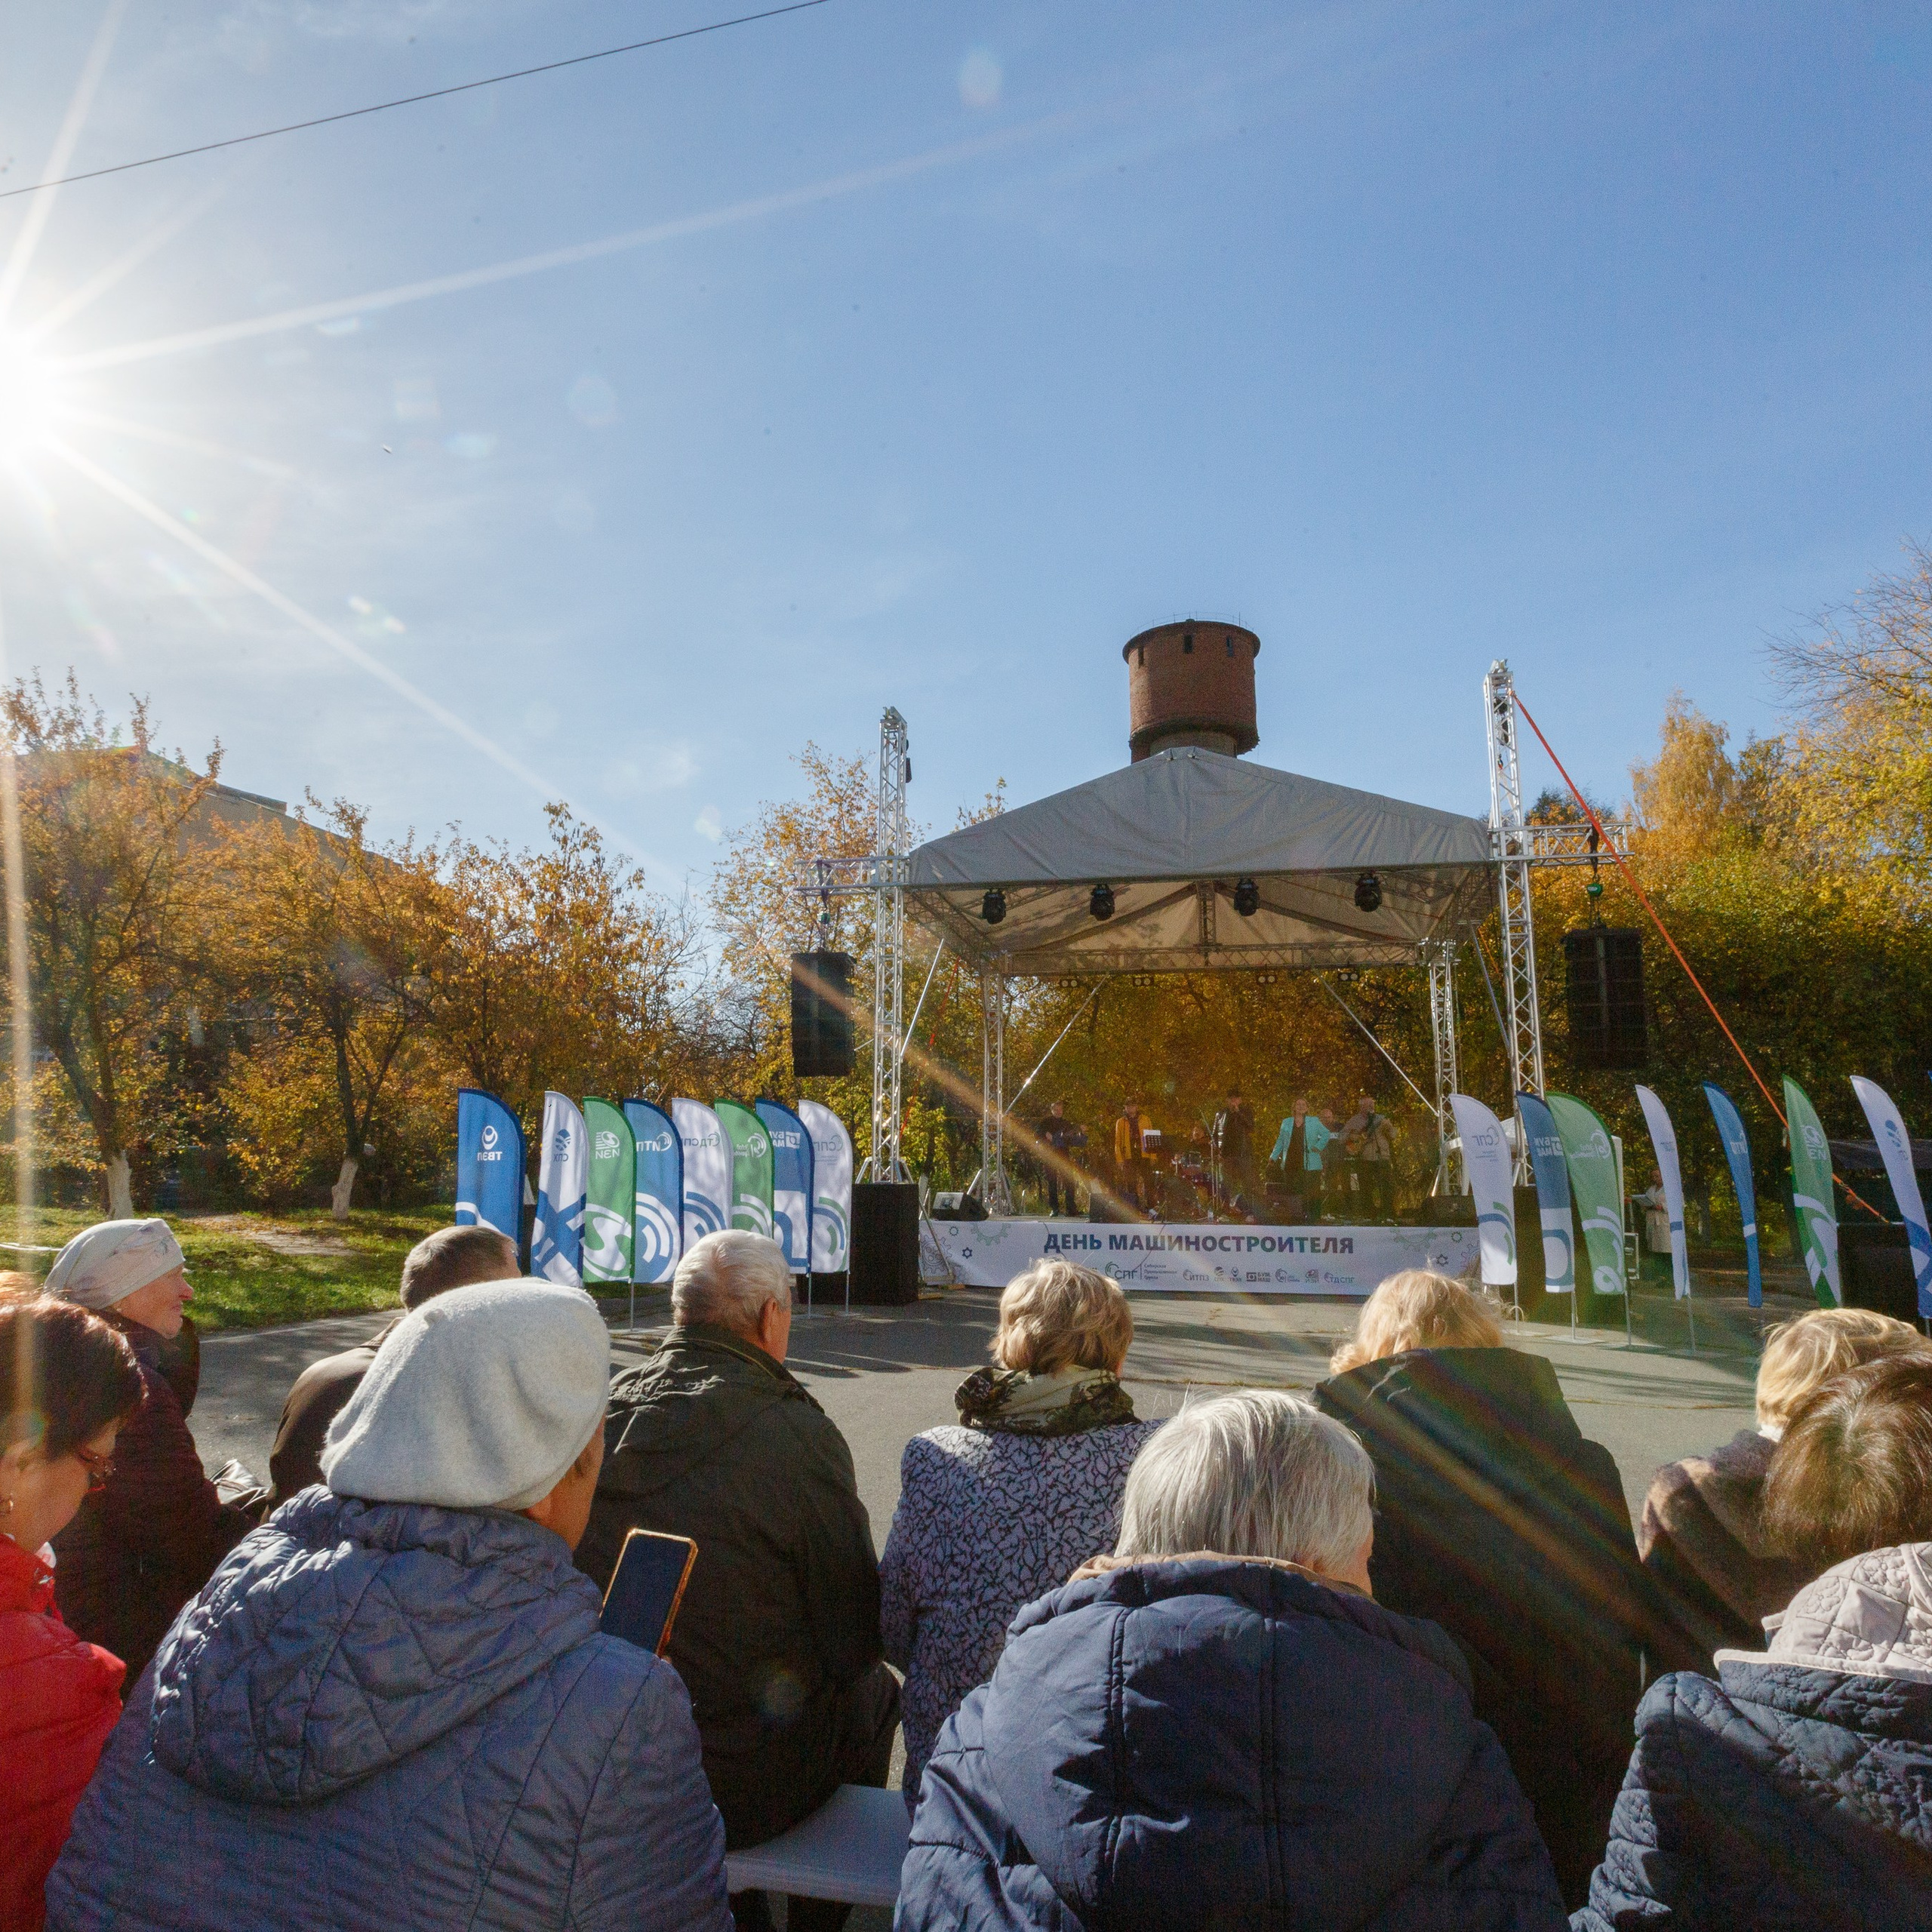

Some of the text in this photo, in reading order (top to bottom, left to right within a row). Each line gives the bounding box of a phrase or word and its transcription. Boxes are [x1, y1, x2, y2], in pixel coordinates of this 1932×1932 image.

[1044, 1234, 1354, 1254] ДЕНЬ МАШИНОСТРОИТЕЛЯ
[1114, 1270, 1137, 1280] СПГ
